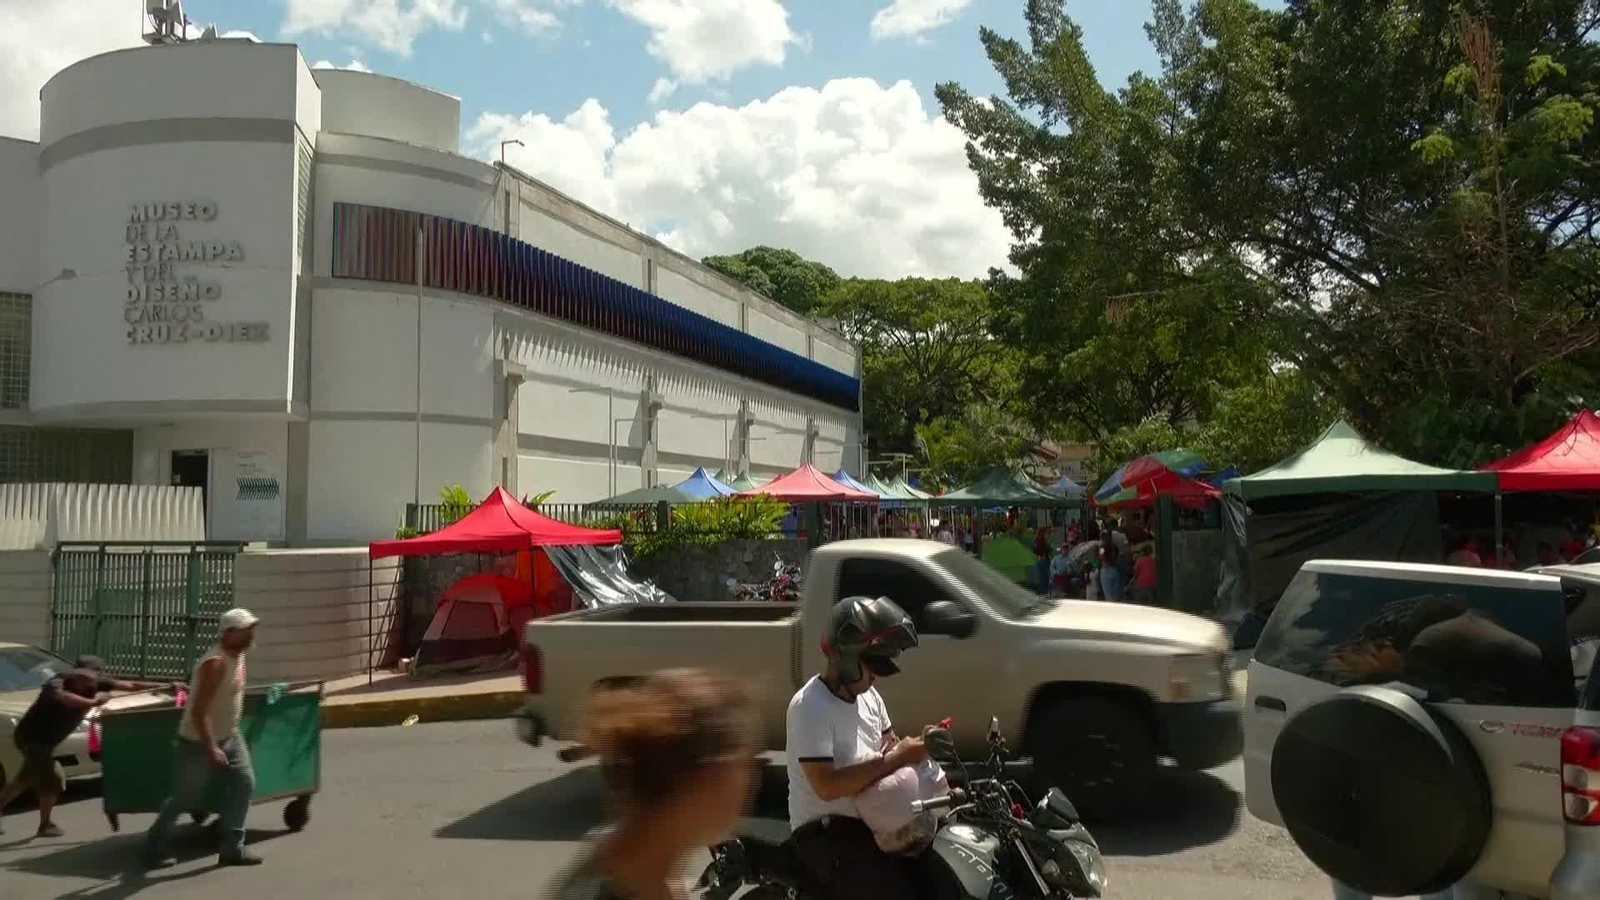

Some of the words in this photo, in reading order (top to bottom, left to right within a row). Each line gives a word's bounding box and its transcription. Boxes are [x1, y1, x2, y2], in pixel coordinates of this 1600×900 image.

[128, 201, 218, 222] MUSEO
[126, 224, 147, 243] DE
[155, 221, 179, 241] LA
[126, 241, 244, 263] ESTAMPA
[125, 266, 140, 283] Y
[143, 263, 174, 283] DEL
[124, 304, 204, 323] CARLOS
